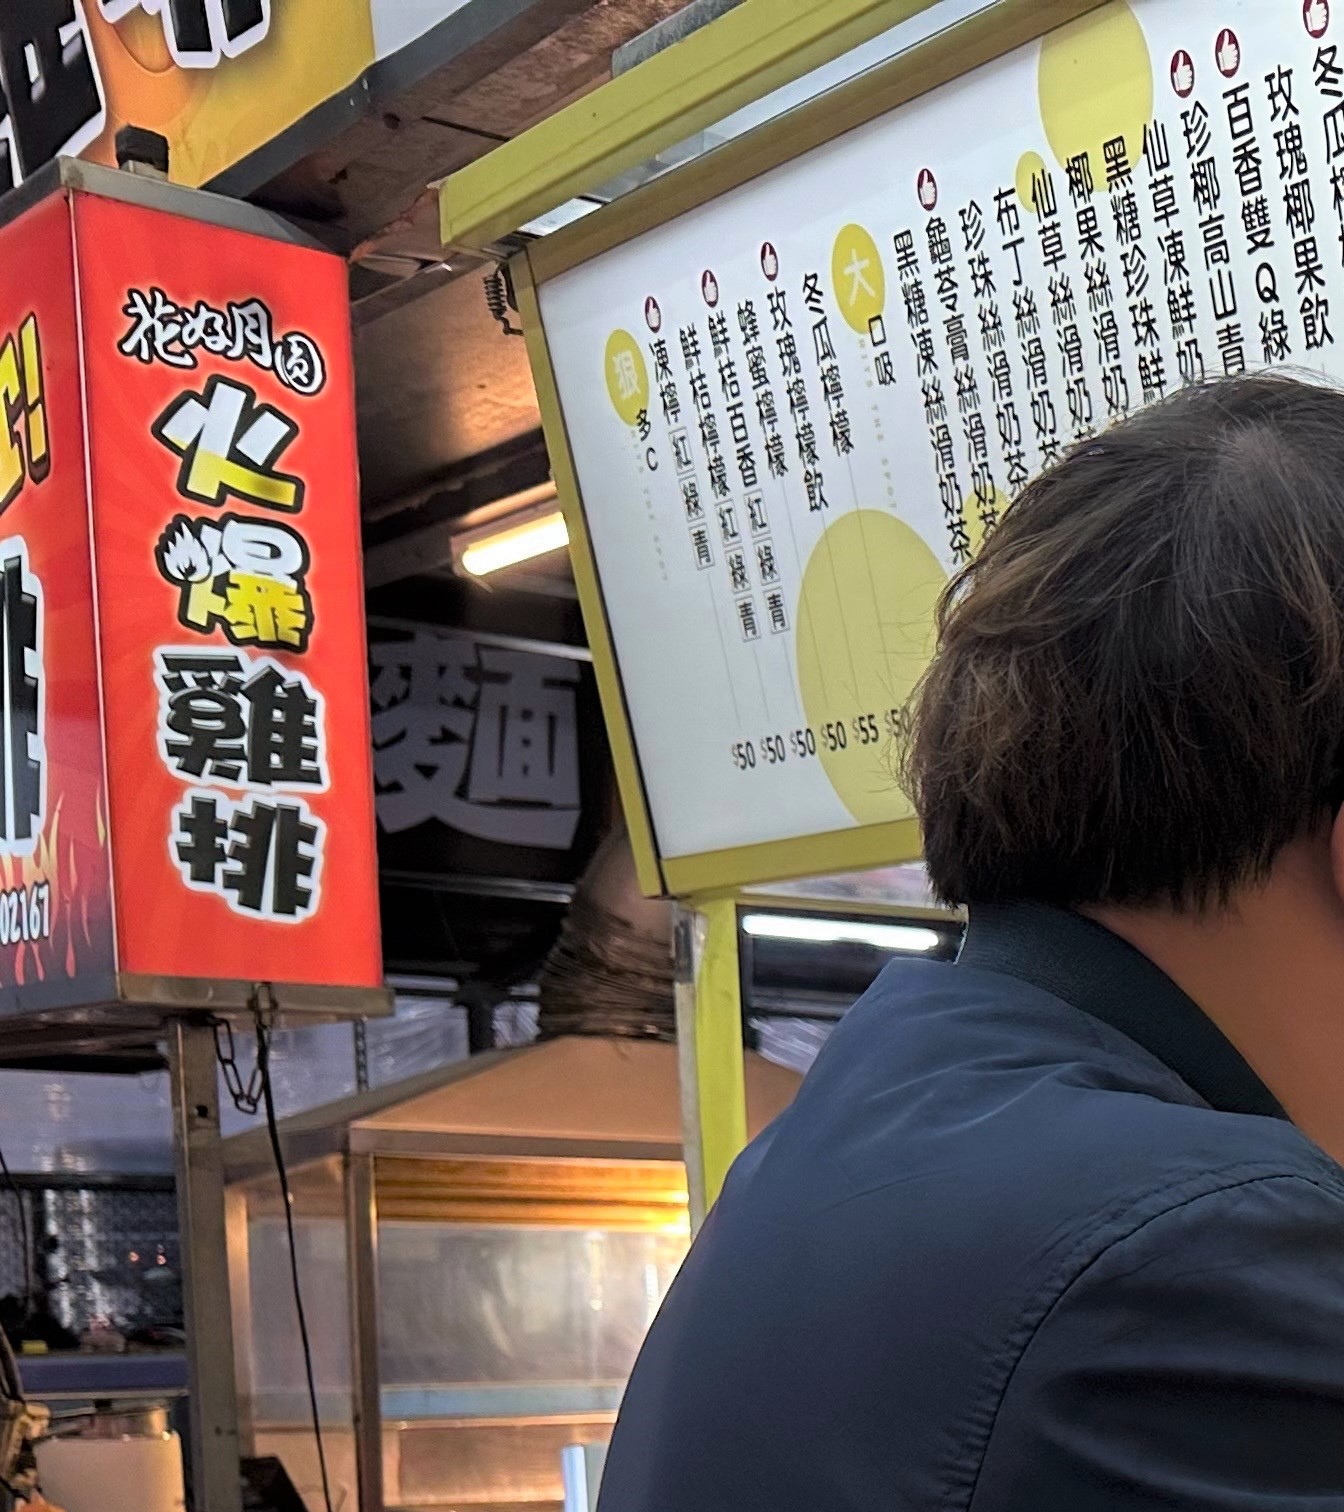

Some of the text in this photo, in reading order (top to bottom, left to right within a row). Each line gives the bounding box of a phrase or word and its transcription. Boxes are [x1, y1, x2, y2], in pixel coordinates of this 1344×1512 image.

[1031, 168, 1096, 442] 仙草絲滑奶
[1222, 82, 1292, 364] 百香雙Q綠
[1264, 64, 1335, 351] 玫瑰椰果飲
[736, 299, 789, 480] 蜂蜜檸檬
[767, 286, 829, 513] 玫瑰檸檬飲
[802, 272, 854, 457] 冬瓜檸檬
[893, 229, 972, 565] 黑糖凍絲滑奶茶
[153, 375, 330, 922] 火爆雞排
[731, 713, 880, 771] $50 $50 $50 $50 $55
